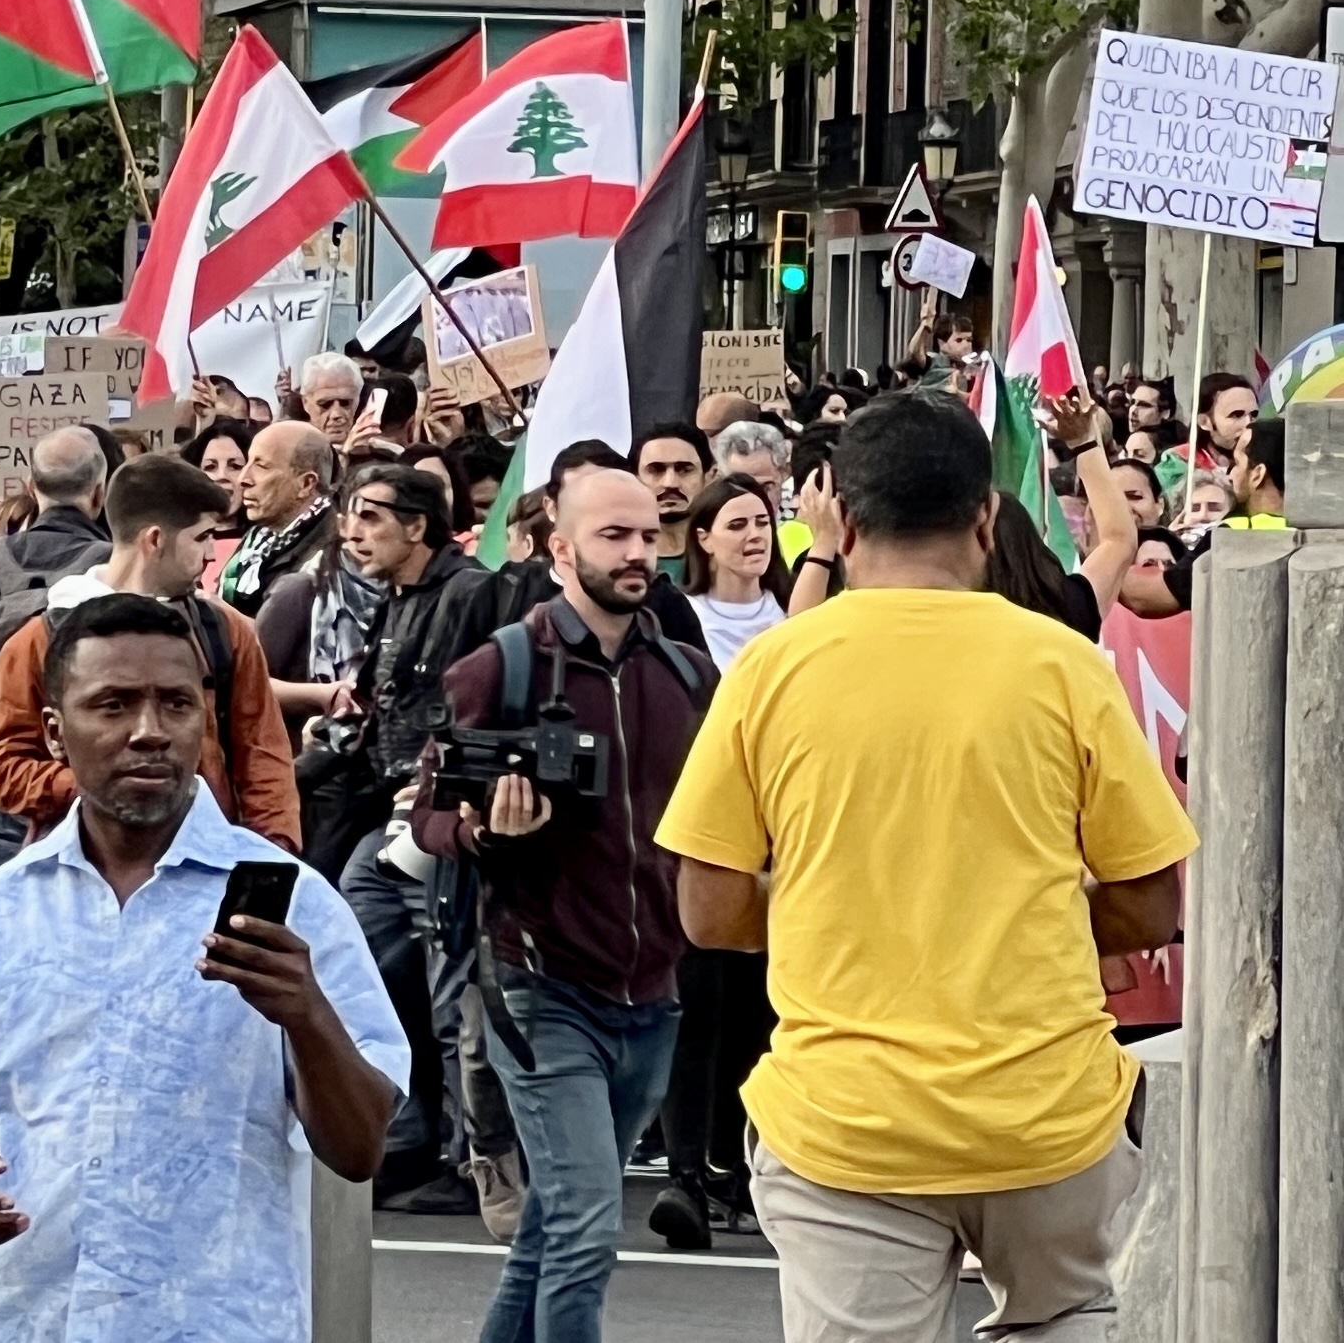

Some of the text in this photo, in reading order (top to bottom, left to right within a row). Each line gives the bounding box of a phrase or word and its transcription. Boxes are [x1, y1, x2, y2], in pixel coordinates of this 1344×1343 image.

[1107, 38, 1321, 100] QUIÉN IBA A DECIR
[1101, 79, 1148, 112] QUE
[1151, 87, 1187, 116] LOS
[1095, 111, 1285, 164] DEL HOLOCAUSTO
[1252, 166, 1285, 193] UN
[1084, 178, 1269, 230] GENOCIDIO
[223, 298, 319, 325] NAME
[46, 314, 109, 337] NOT
[64, 346, 93, 371] IF
[0, 383, 87, 408] GAZA
